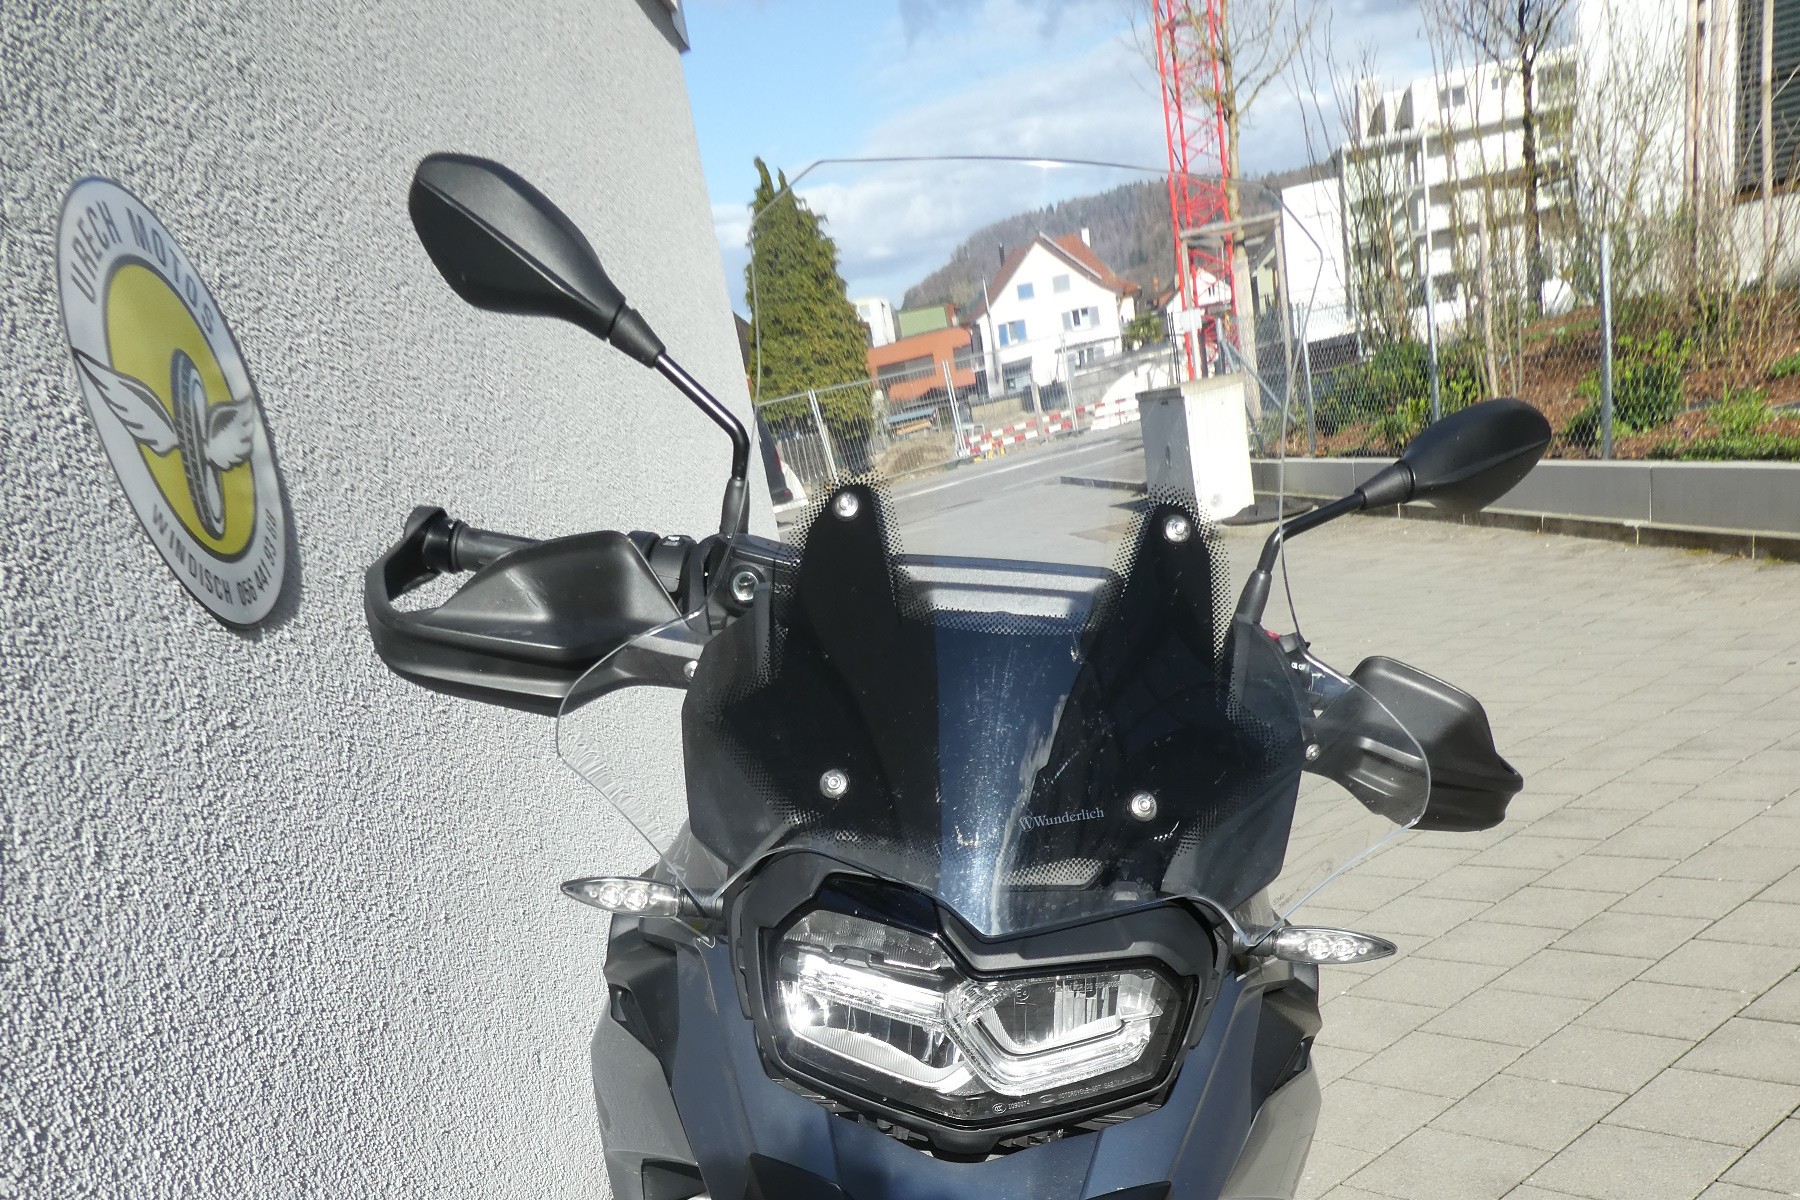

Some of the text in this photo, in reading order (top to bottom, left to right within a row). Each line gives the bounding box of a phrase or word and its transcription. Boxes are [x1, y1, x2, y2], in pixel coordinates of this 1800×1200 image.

[71, 200, 214, 334] URECH MOTOS
[152, 503, 234, 605] WINDISCH
[1034, 806, 1105, 828] Wunderlich
